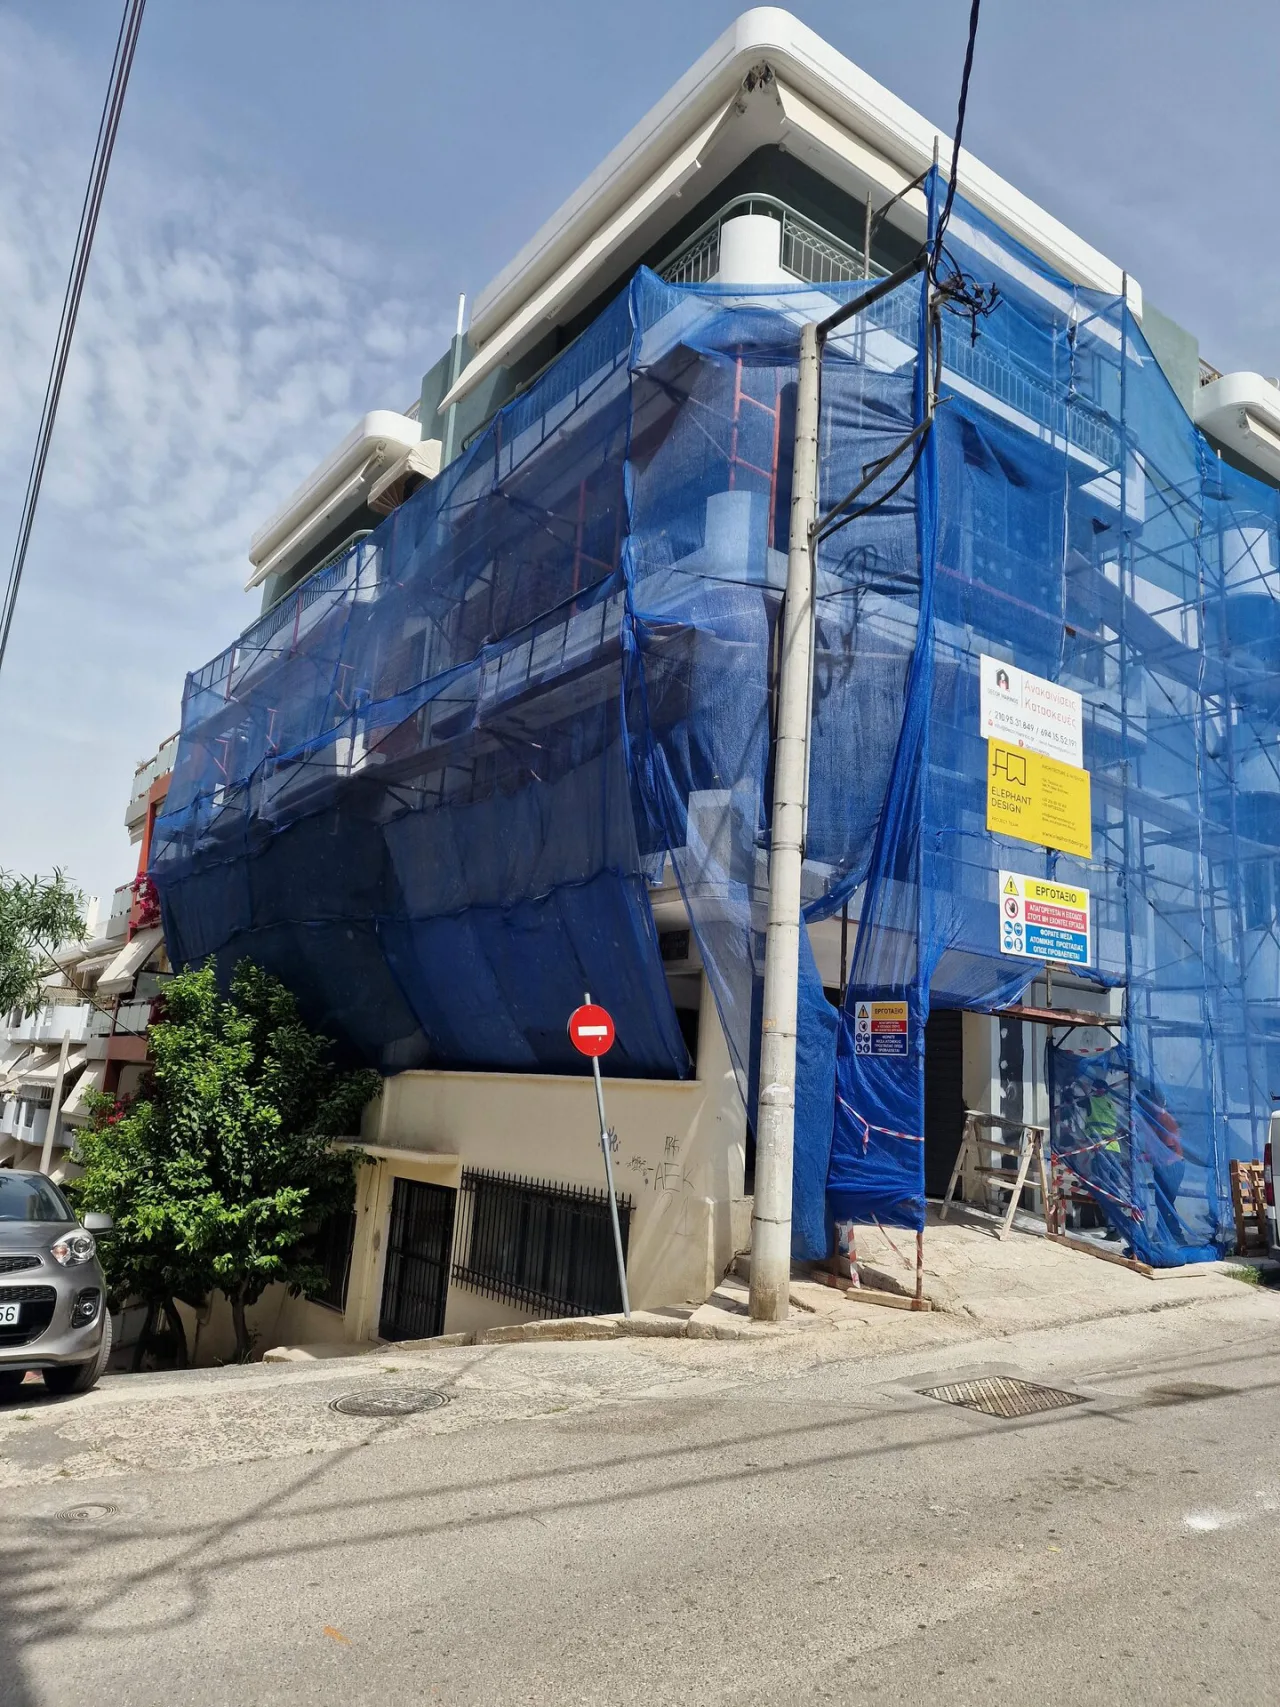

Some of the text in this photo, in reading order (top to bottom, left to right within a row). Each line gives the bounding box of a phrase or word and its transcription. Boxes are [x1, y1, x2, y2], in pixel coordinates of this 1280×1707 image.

[1024, 680, 1076, 712] Ανακαινίσεις
[1025, 697, 1076, 730] Κατασκευές
[992, 786, 1032, 806] ELEPHANT
[992, 798, 1021, 814] DESIGN
[1036, 886, 1076, 903] ΕΡΓΟΤΑΞΙΟ
